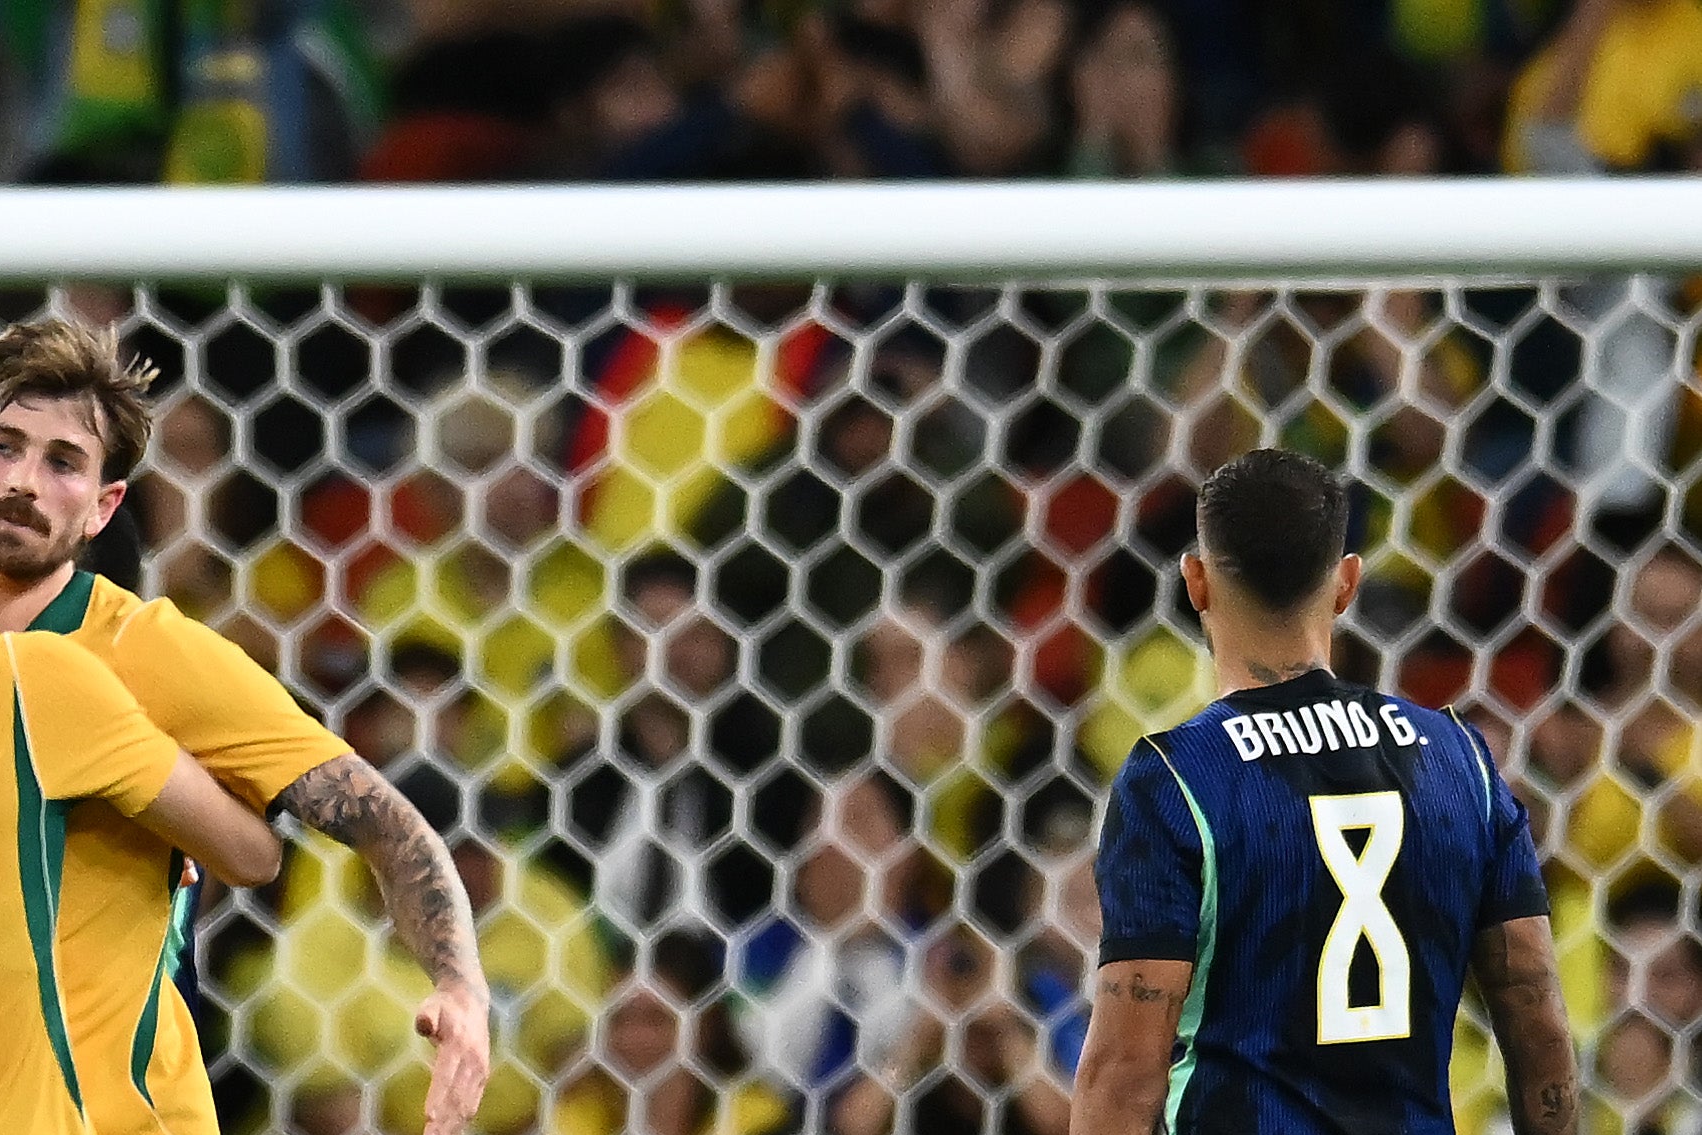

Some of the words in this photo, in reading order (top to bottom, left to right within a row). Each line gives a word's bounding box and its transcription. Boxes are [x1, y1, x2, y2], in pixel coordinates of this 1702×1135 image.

[1222, 700, 1379, 761] BRUNO
[1379, 704, 1429, 747] G.
[1309, 791, 1411, 1045] 8
